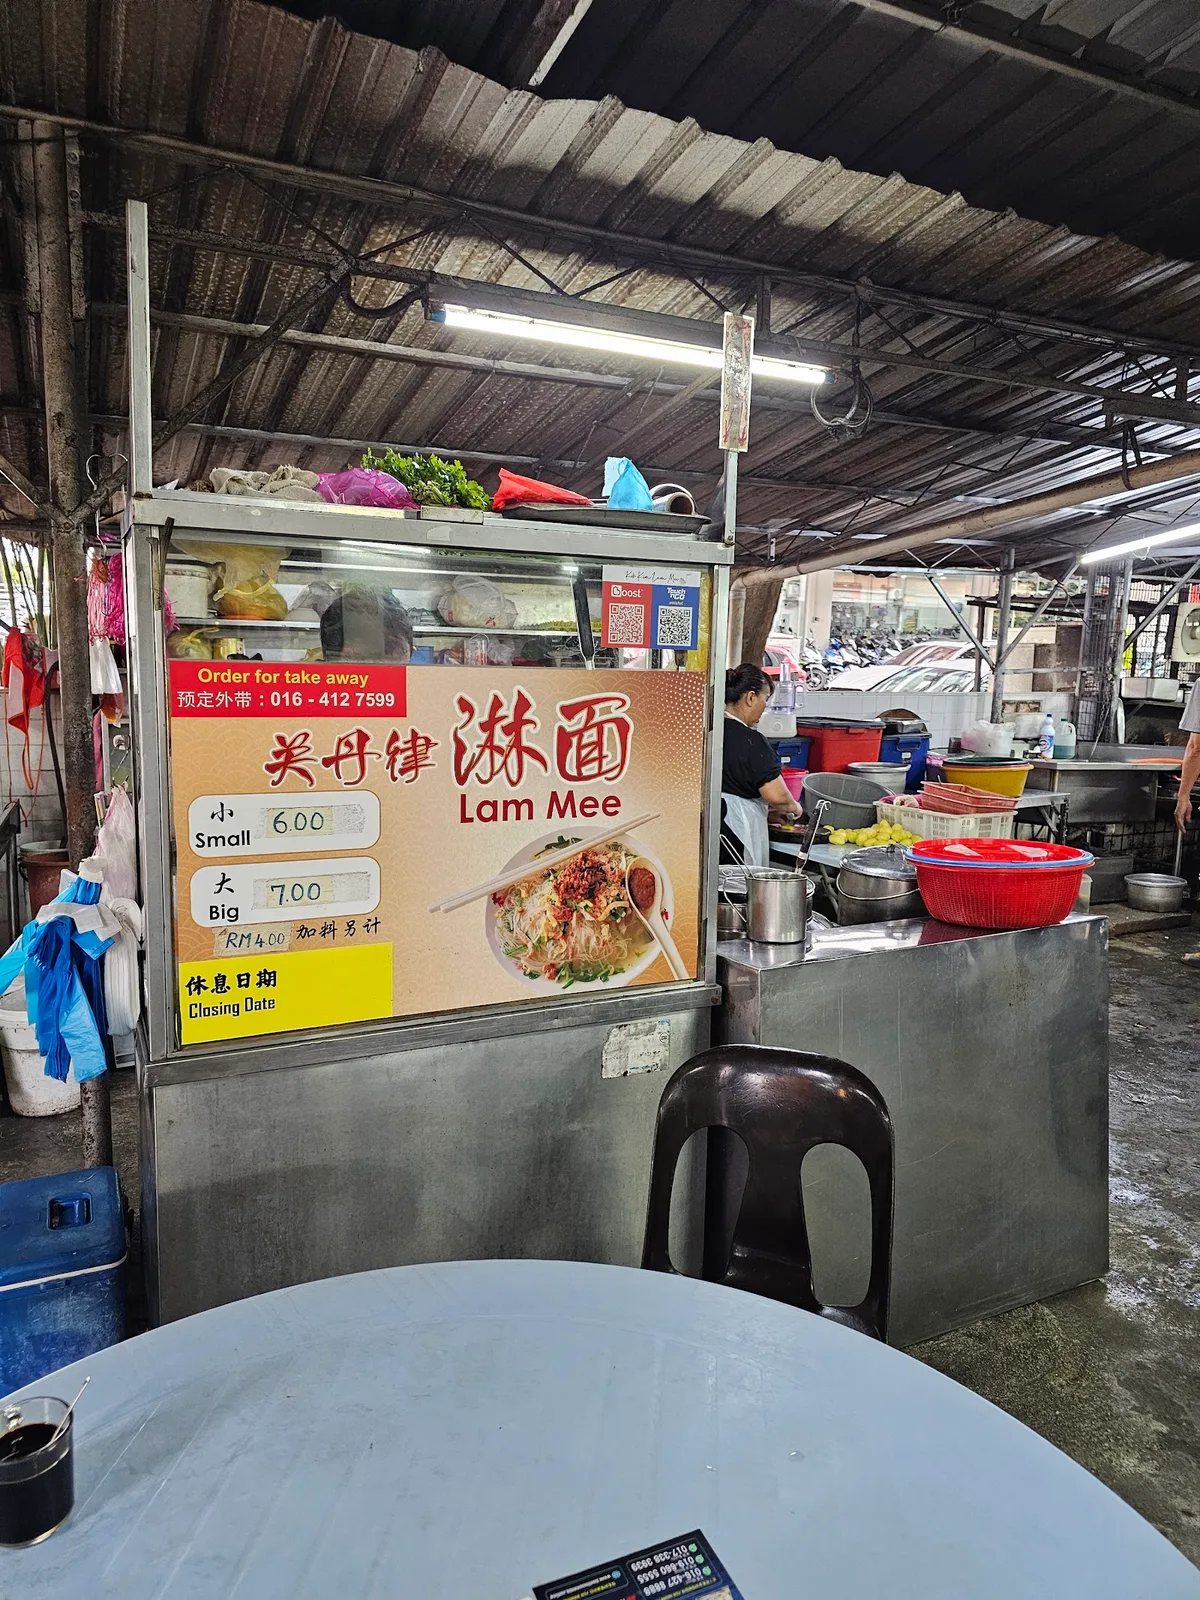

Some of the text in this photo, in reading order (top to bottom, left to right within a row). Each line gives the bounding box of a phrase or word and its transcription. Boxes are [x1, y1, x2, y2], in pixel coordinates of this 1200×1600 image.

[667, 587, 686, 595] Touch
[197, 668, 369, 688] Order for take away
[270, 691, 303, 707] 016
[319, 691, 350, 707] 412
[355, 692, 395, 707] 7599
[210, 801, 234, 822] 小
[460, 790, 622, 823] Lam Mee
[272, 811, 324, 834] 6.00
[195, 830, 251, 848] Small
[213, 872, 235, 894] 大
[270, 882, 321, 906] 7.00
[209, 904, 239, 922] Big
[296, 916, 381, 940] 加料另计
[185, 968, 277, 996] 休息日期
[189, 996, 276, 1019] Closing Date
